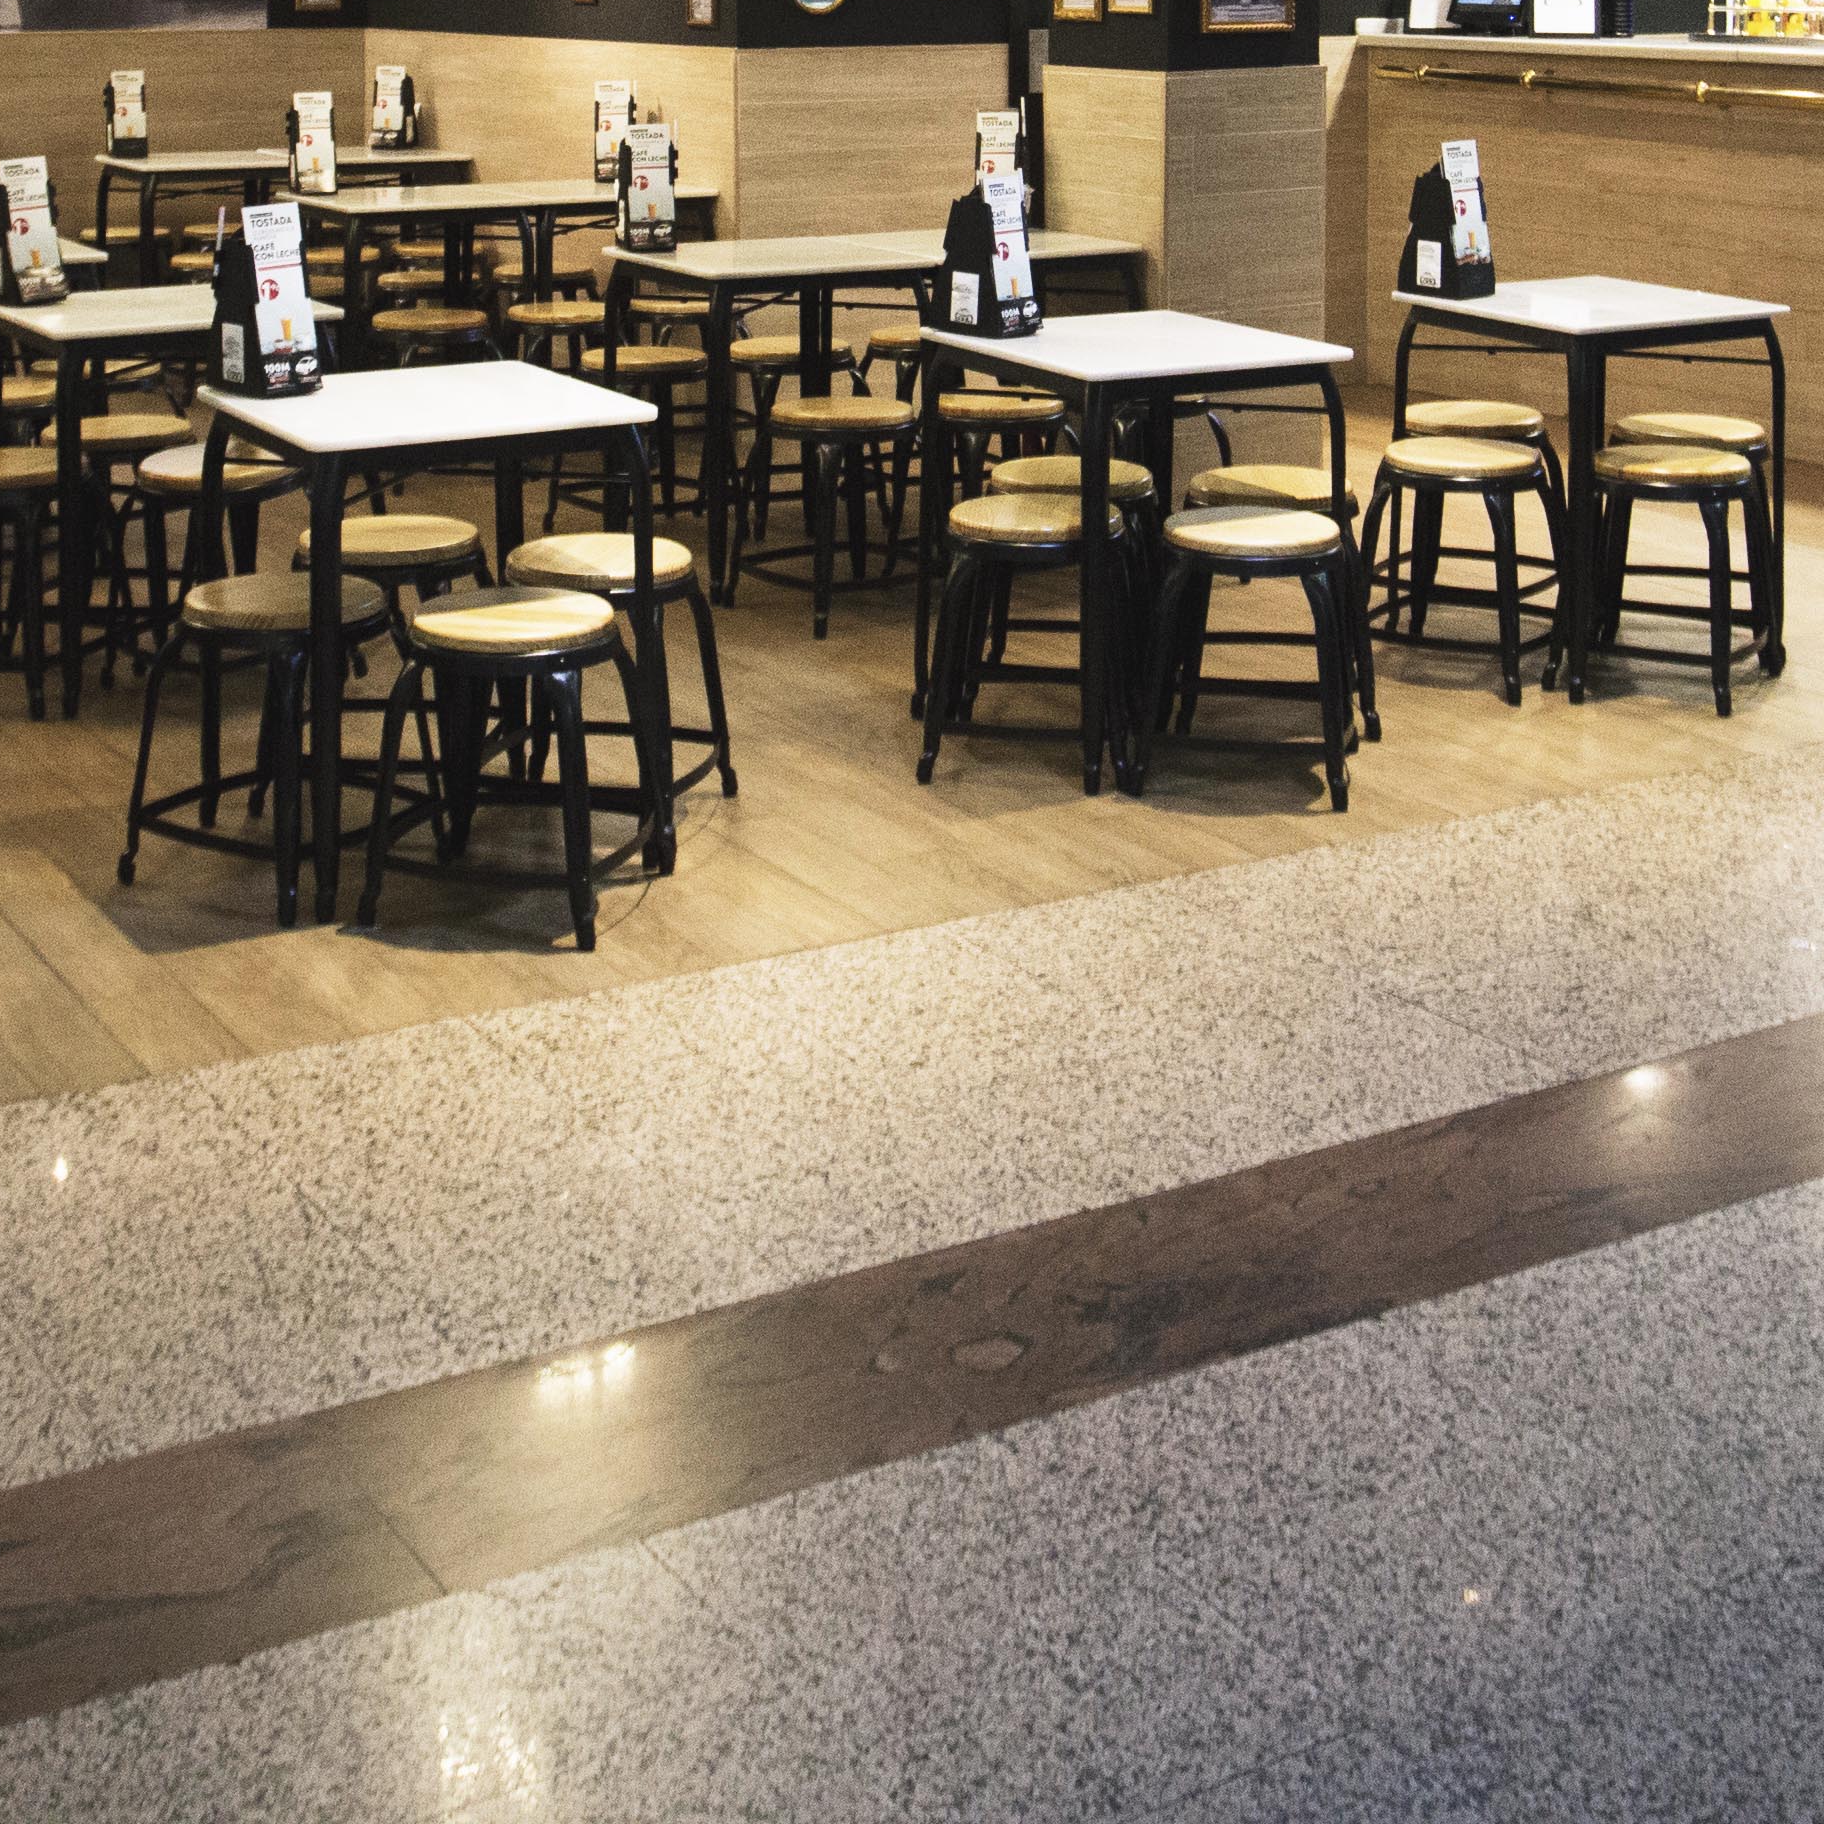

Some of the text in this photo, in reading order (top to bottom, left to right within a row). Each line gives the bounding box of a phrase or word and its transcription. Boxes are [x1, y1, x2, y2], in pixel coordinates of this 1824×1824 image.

[631, 132, 664, 140] TOSTADA
[250, 216, 293, 229] TOSTADA
[255, 252, 275, 261] CON
